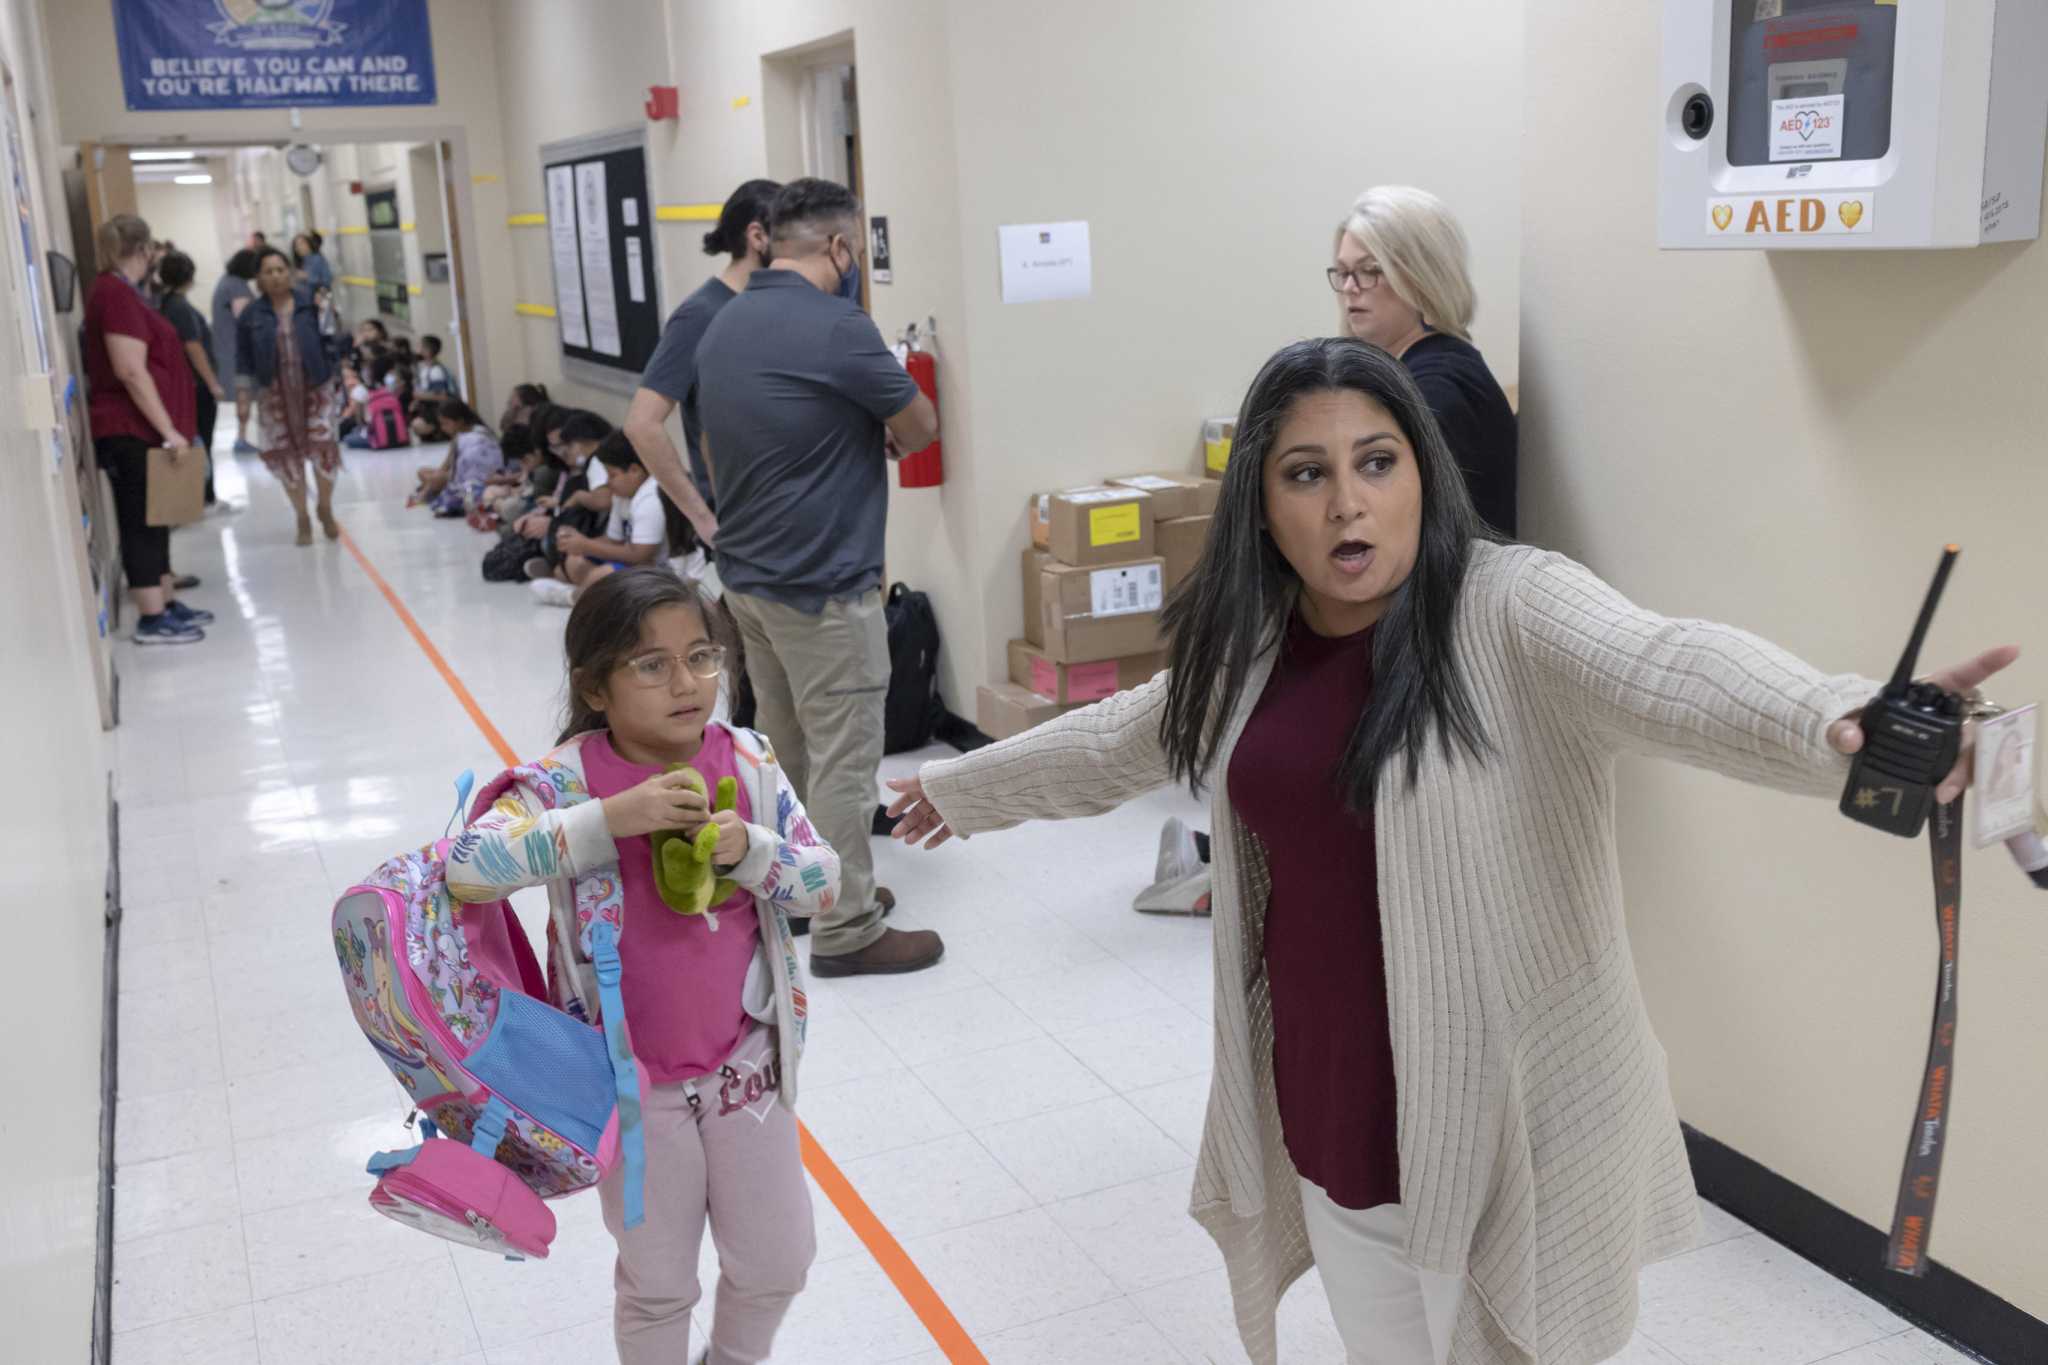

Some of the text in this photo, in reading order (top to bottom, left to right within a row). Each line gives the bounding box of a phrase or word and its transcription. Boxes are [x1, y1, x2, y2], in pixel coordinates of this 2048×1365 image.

[150, 55, 408, 77] BELIEVE YOU CAN AND
[143, 74, 420, 97] YOU'RE HALFWAY THERE
[1780, 116, 1831, 132] AED 123
[1745, 198, 1826, 233] AED
